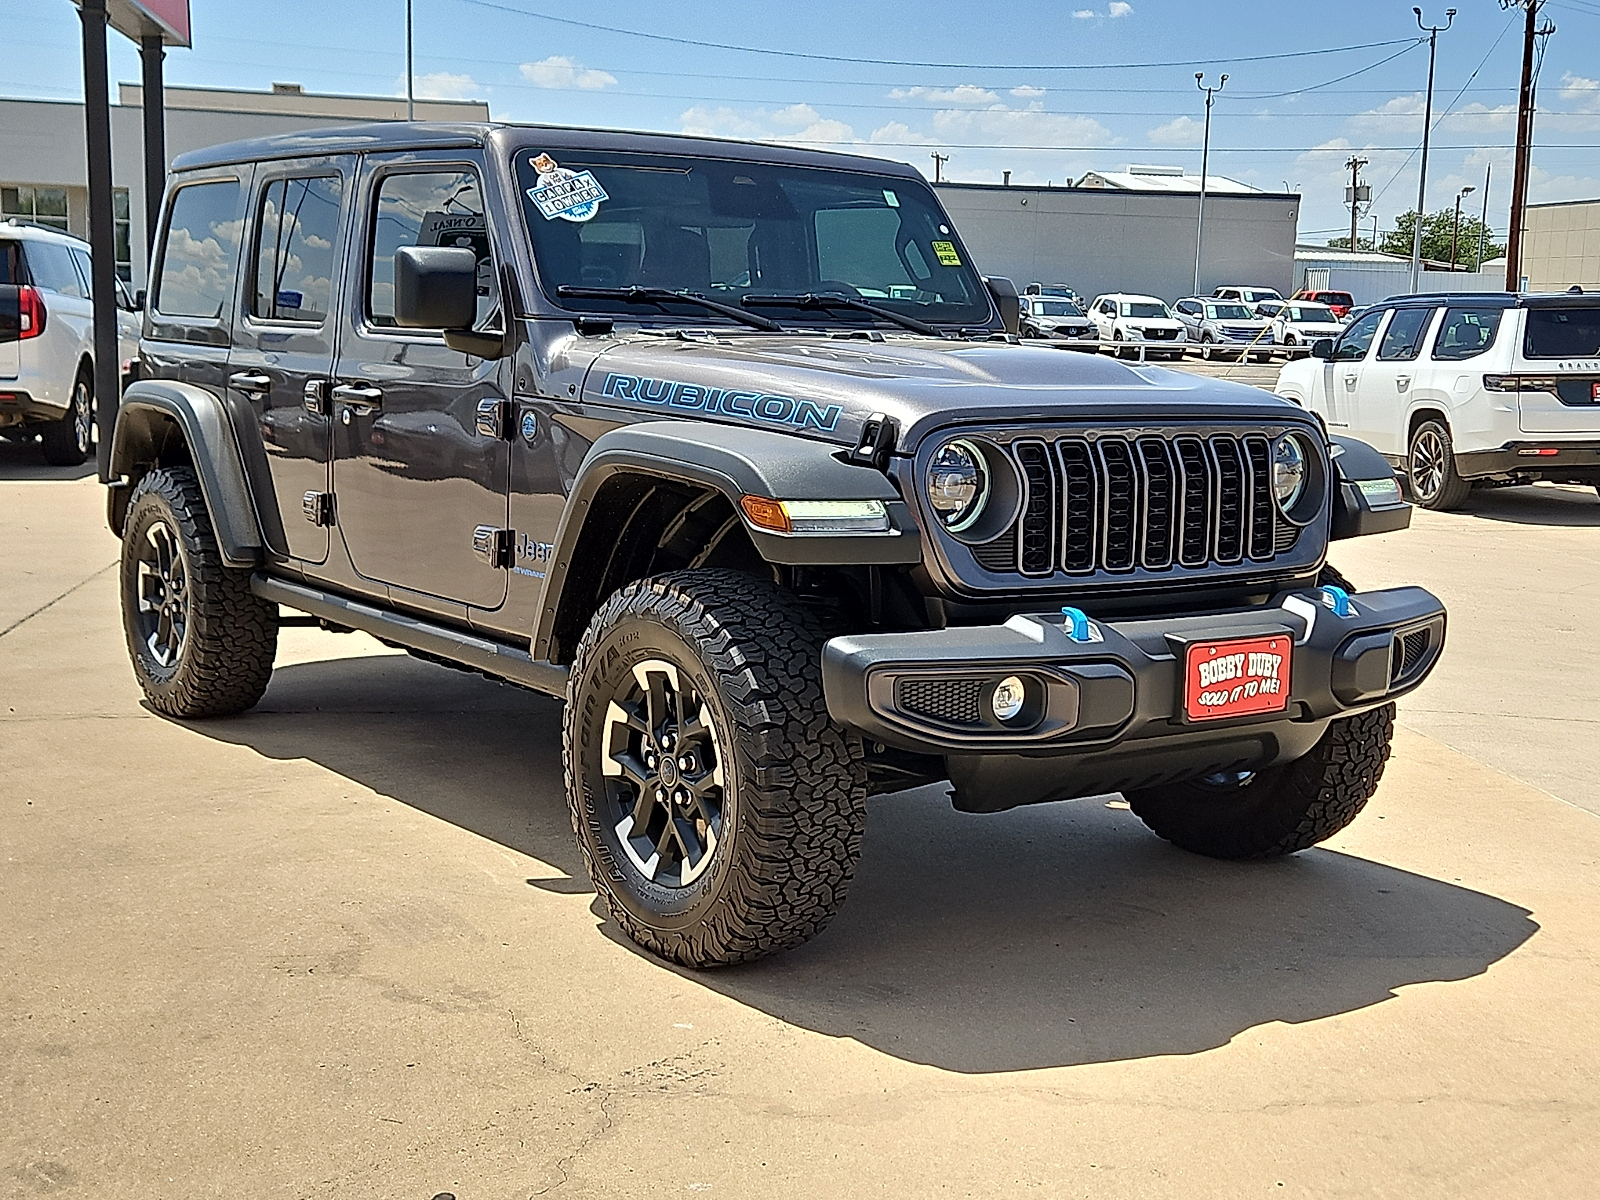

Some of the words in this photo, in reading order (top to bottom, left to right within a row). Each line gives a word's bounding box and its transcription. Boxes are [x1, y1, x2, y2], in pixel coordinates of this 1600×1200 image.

[535, 178, 593, 202] CARFAX
[545, 203, 554, 213] 1
[553, 187, 601, 211] OWNER
[602, 372, 844, 432] RUBICON
[590, 644, 620, 691] T/A
[1198, 653, 1246, 688] BOBBY
[1247, 652, 1283, 679] DUBY
[1197, 690, 1229, 706] SOLD
[1229, 685, 1244, 703] IT
[1243, 681, 1259, 699] TO
[1259, 678, 1281, 695] ME!
